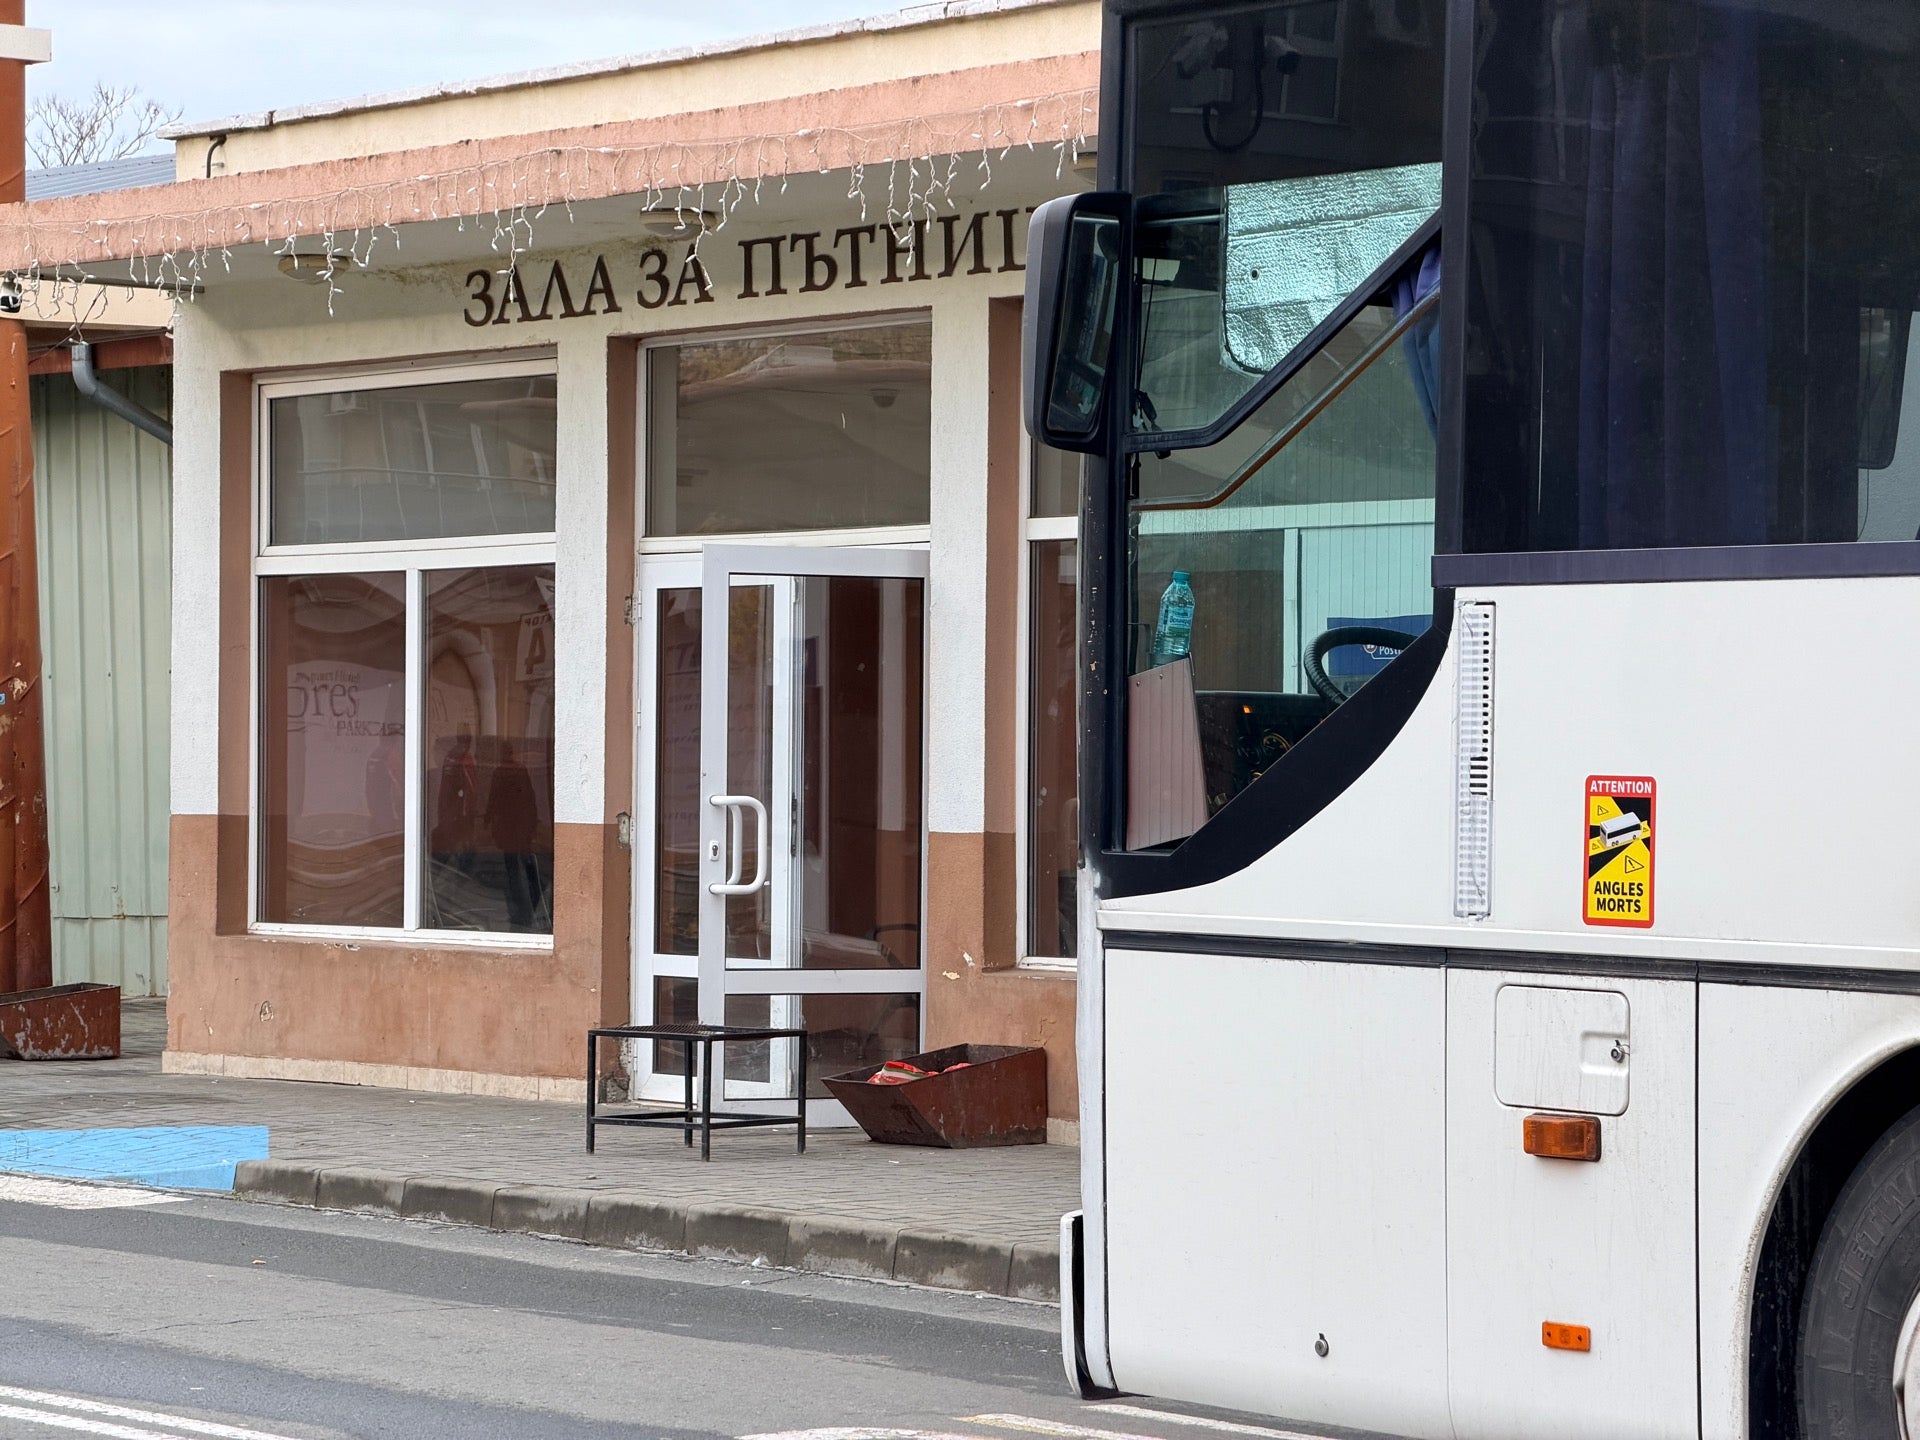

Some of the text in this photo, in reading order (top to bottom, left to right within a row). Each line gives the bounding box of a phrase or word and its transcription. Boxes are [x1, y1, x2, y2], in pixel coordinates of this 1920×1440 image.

[464, 253, 622, 327] ЗАЛА
[636, 239, 715, 309] ЗА
[1590, 780, 1652, 794] ATTENTION
[1594, 881, 1644, 897] ANGLES
[1596, 898, 1641, 913] MORTS
